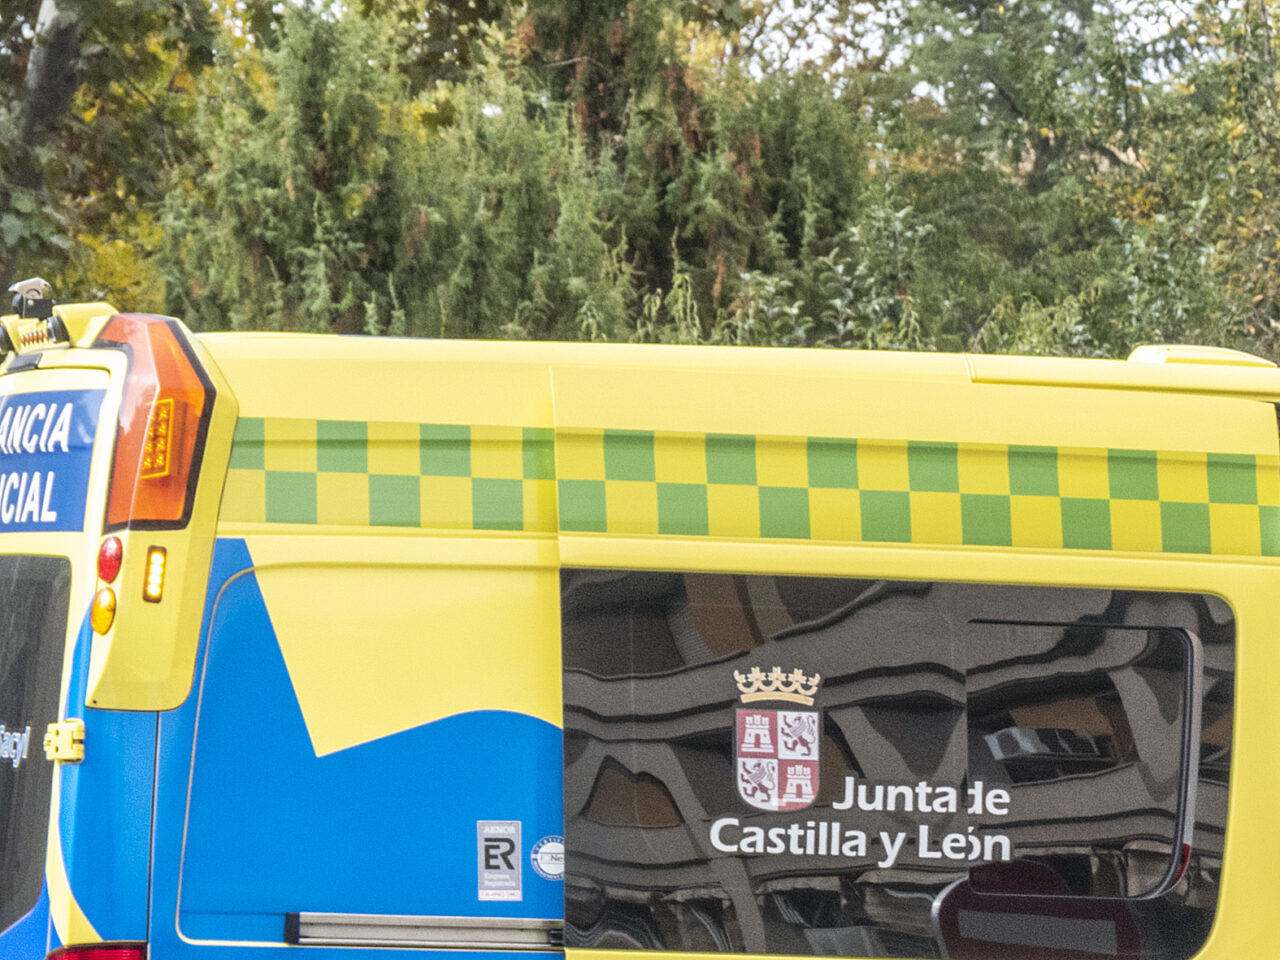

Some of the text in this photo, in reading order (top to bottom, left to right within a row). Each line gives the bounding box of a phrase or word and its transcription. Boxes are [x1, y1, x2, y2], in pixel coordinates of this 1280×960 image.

[0, 471, 57, 524] CIAL
[833, 777, 1011, 815] Junta de
[484, 837, 516, 871] ER
[709, 818, 1011, 868] Castilla y León
